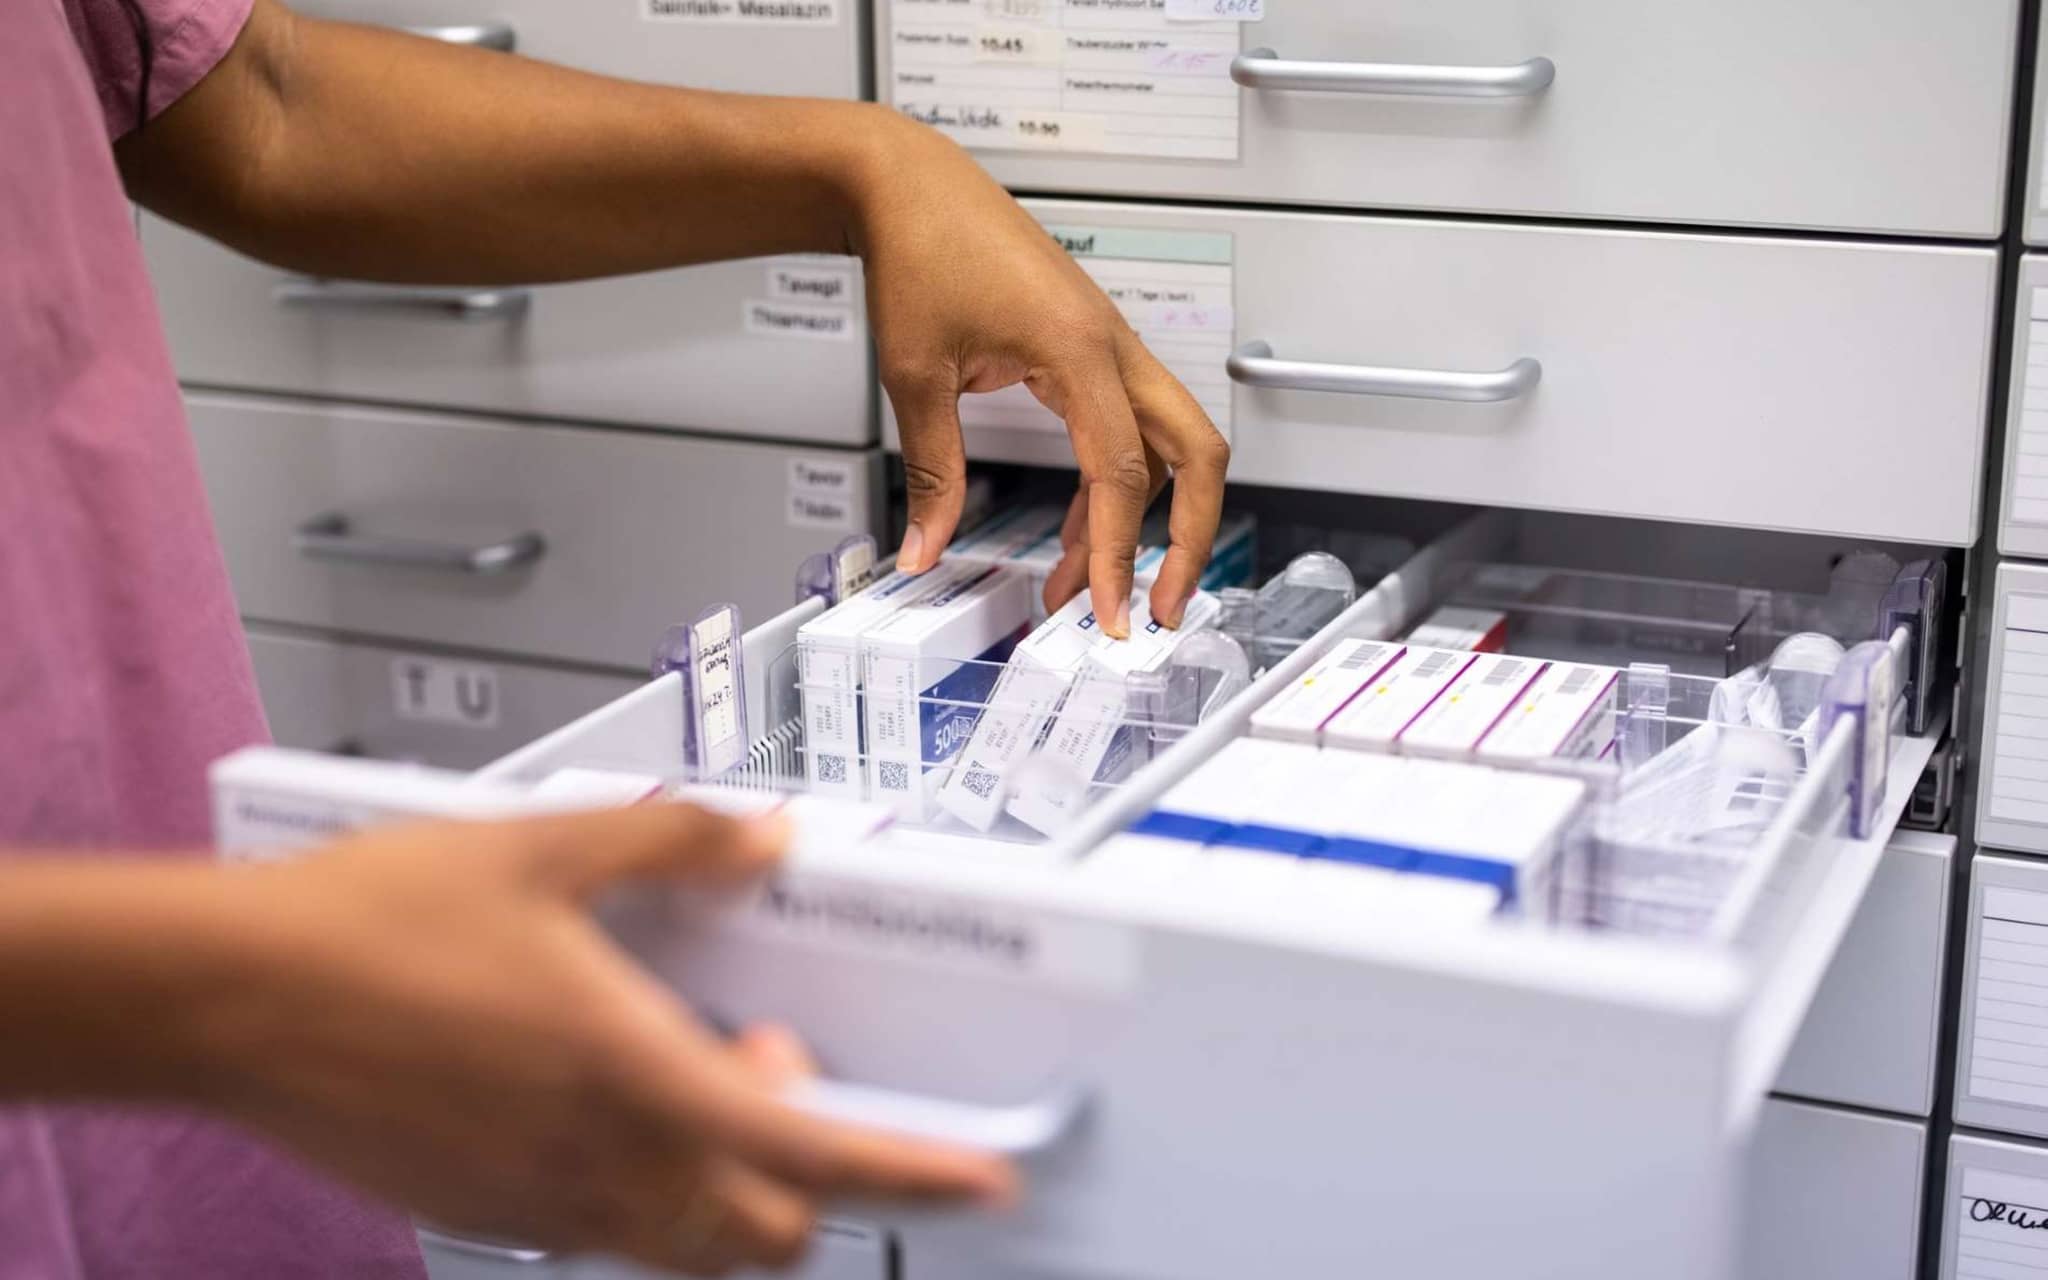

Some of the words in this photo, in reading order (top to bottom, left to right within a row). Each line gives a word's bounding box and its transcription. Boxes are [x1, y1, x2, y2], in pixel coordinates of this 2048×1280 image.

[1066, 37, 1134, 49] Traubenzucker
[1066, 79, 1154, 92] Fieberthermometer
[777, 271, 843, 298] Tavegil
[752, 306, 844, 333] Thiamazol
[403, 664, 431, 707] T
[455, 672, 492, 721] U
